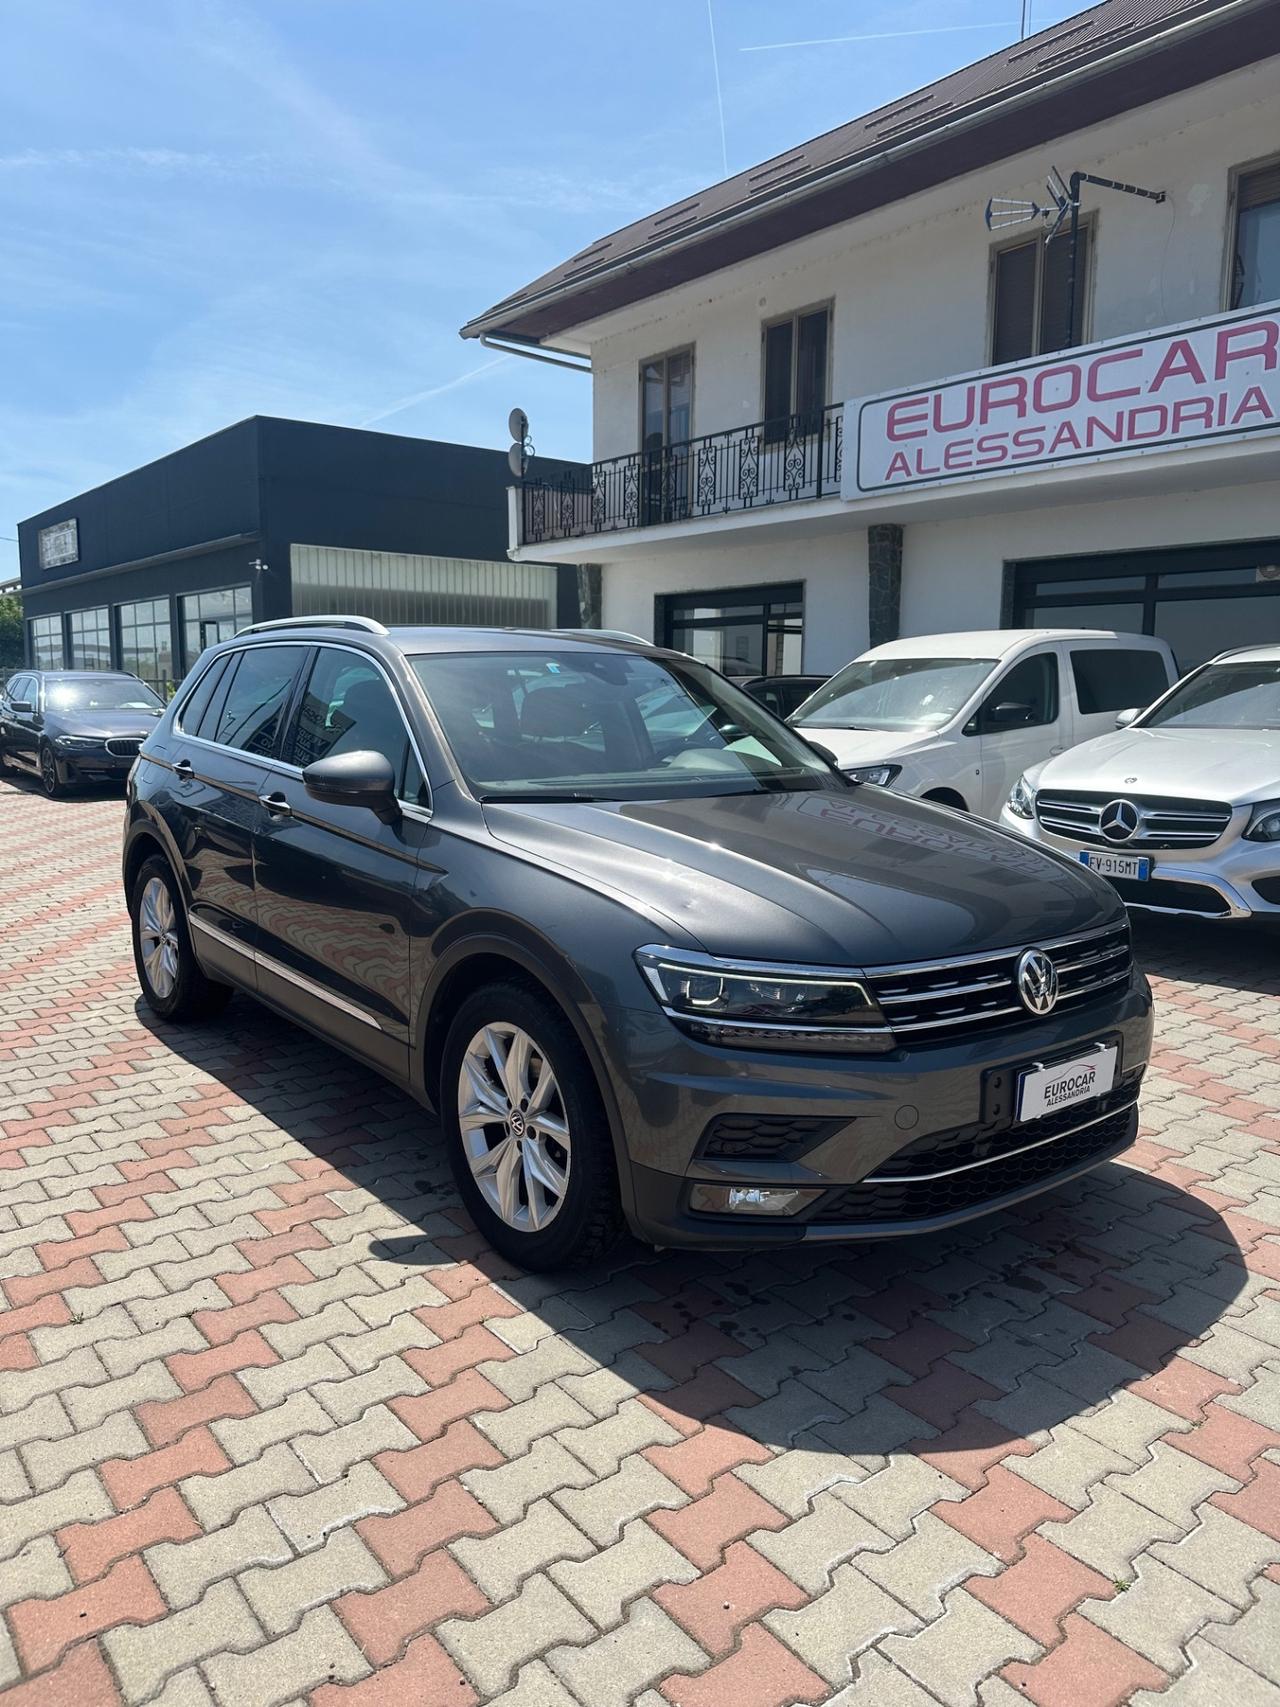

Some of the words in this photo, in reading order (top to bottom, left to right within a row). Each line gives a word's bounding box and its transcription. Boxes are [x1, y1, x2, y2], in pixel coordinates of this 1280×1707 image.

[886, 320, 1279, 442] EUROCAR
[884, 386, 1275, 481] ALESSANDRIA
[1044, 1071, 1096, 1099] EUROCAR
[1046, 1085, 1091, 1107] ALESSANDRIA
